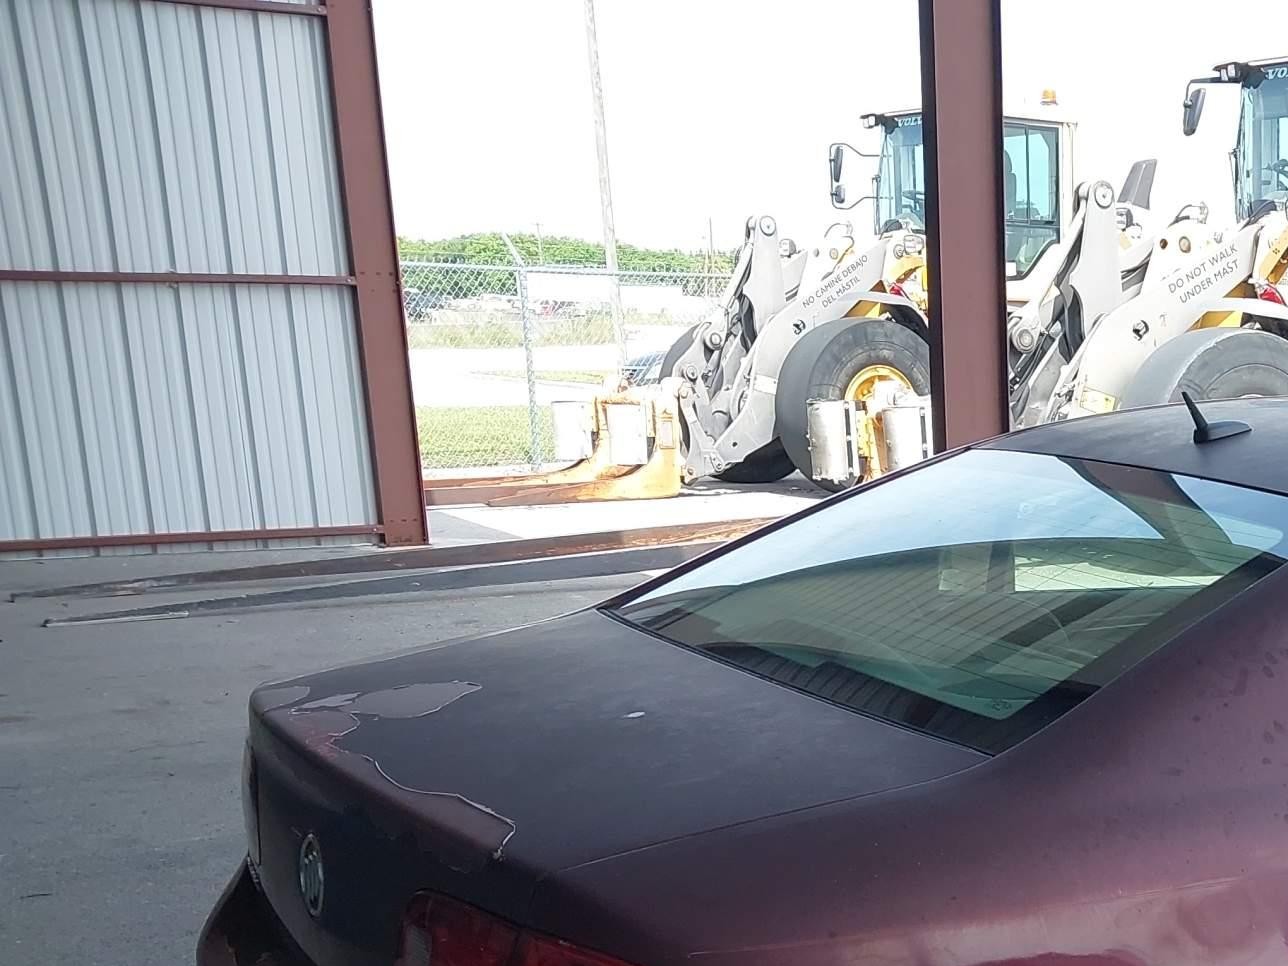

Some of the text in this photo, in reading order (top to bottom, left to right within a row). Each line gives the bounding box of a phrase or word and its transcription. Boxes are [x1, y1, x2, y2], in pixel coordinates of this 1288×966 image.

[802, 254, 868, 308] NO CAMINE DEBAJO
[1168, 244, 1238, 293] DO NOT WALK
[1179, 258, 1239, 304] UNDER MAST
[822, 294, 837, 308] DEL
